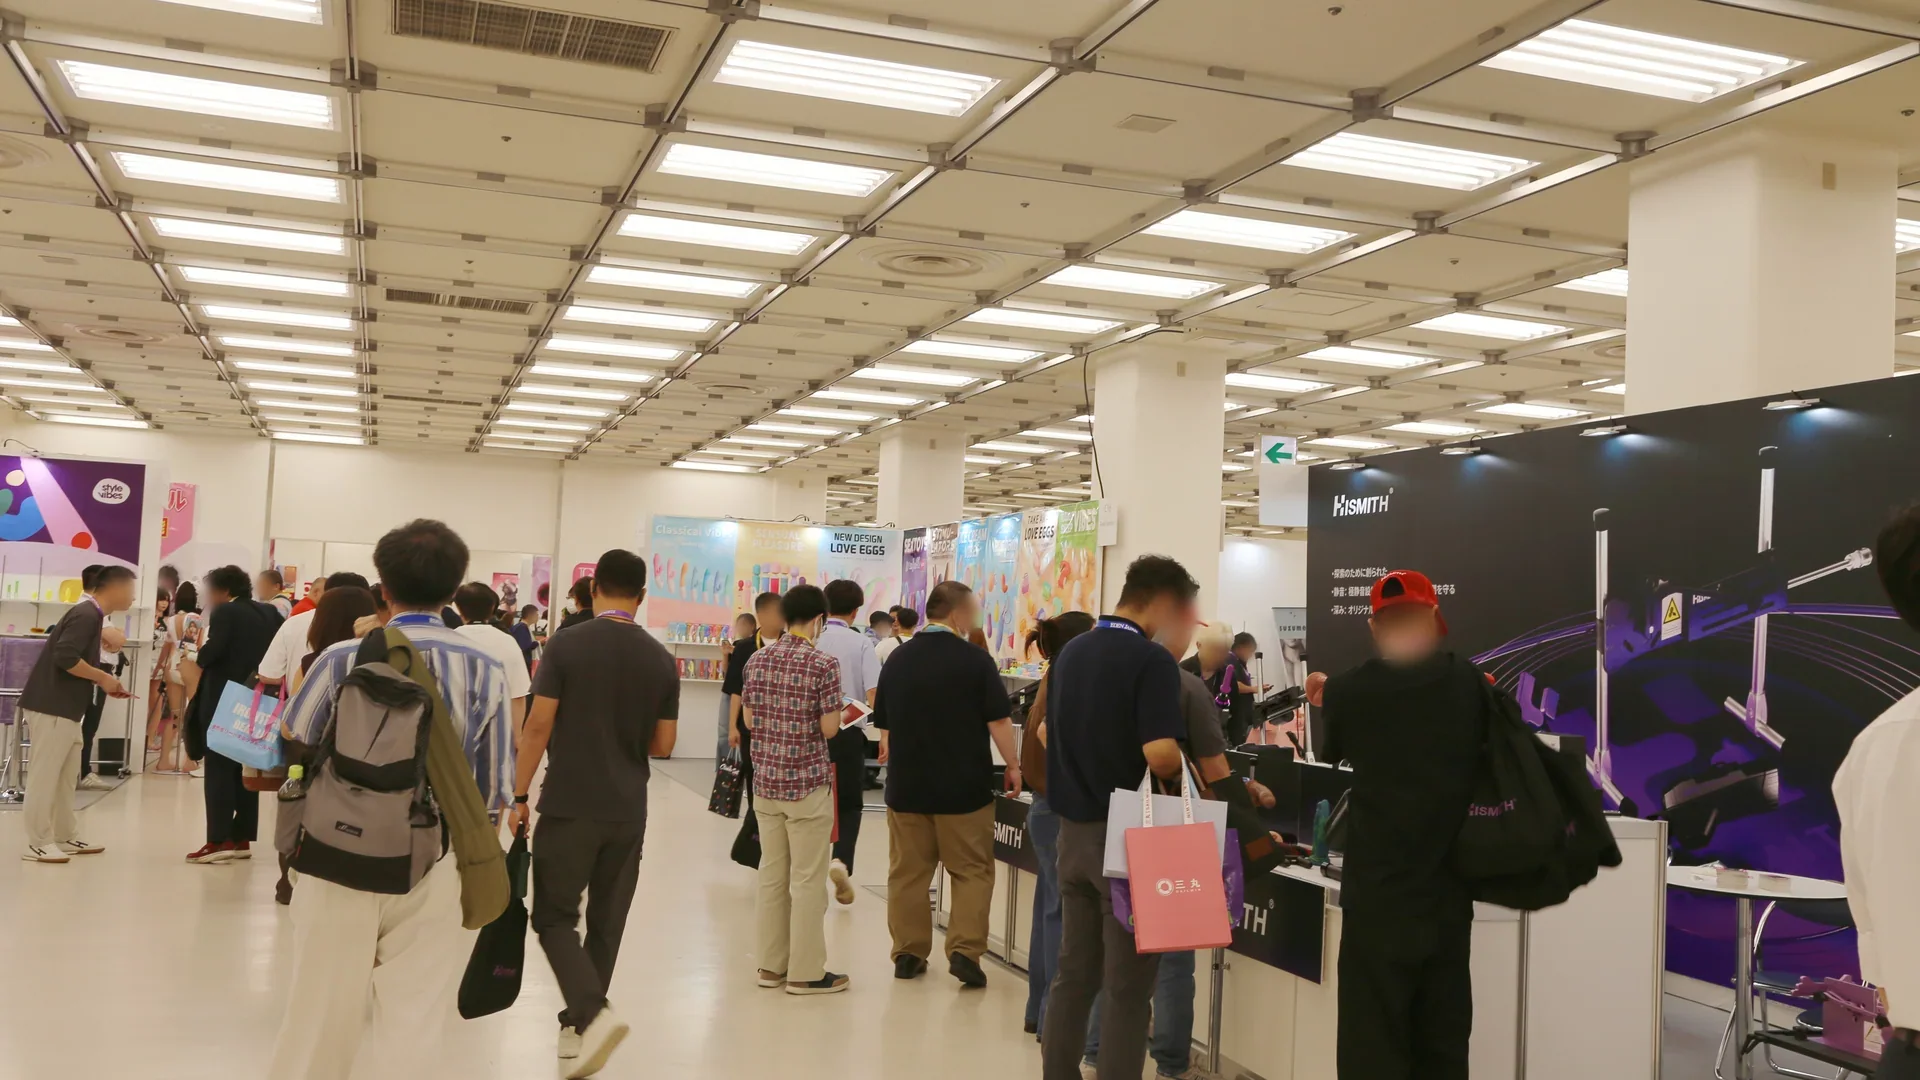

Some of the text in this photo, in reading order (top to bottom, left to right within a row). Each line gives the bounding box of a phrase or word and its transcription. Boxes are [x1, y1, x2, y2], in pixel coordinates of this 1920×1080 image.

[102, 484, 123, 492] style
[98, 491, 123, 499] vibes
[655, 524, 733, 539] Classical Vibs
[834, 532, 883, 543] NEW DESIGN
[1025, 525, 1055, 540] LOVE EGGS
[830, 543, 886, 556] LOVE EGGS
